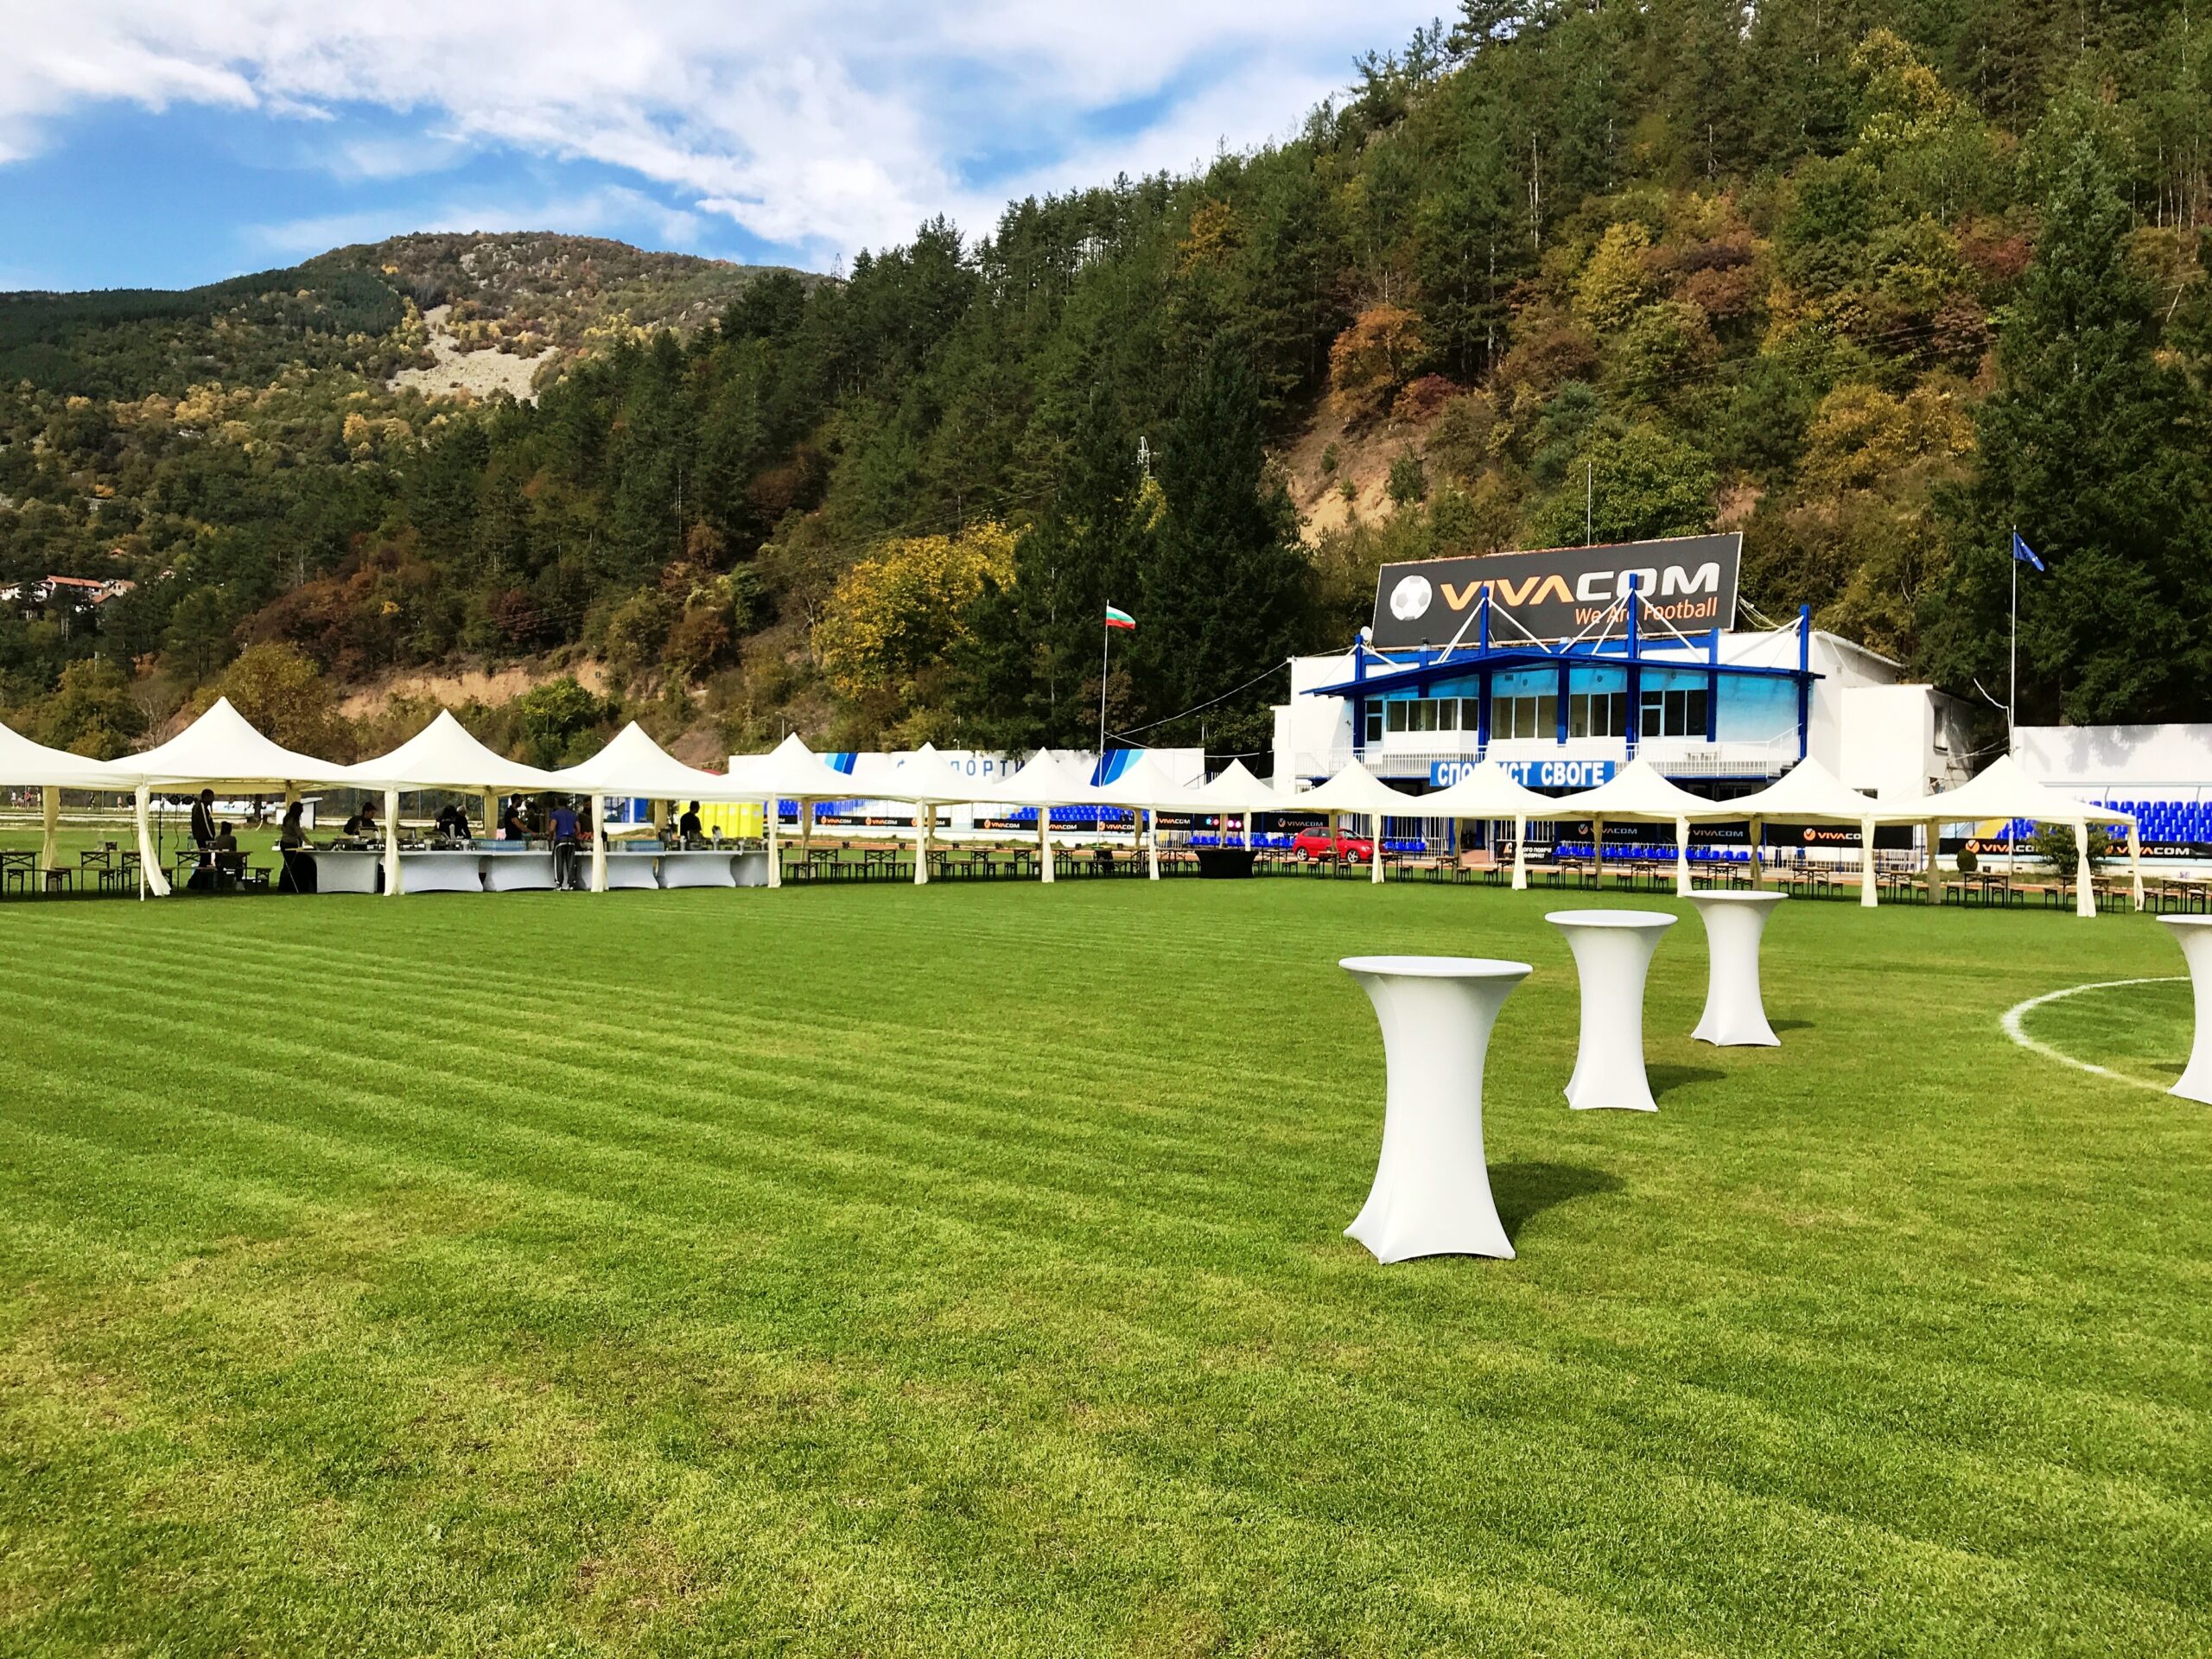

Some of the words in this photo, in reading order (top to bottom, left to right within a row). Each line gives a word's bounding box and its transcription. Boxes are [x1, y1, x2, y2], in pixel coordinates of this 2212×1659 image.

[1440, 562, 1720, 610] VIVACOM
[1575, 607, 1602, 625] We
[1643, 596, 1718, 620] Football
[1438, 763, 1532, 785] СПОСТ
[1541, 762, 1605, 785] СВОГЕ
[1817, 831, 1862, 840] VIVACO
[1982, 843, 2035, 854] VIVACO
